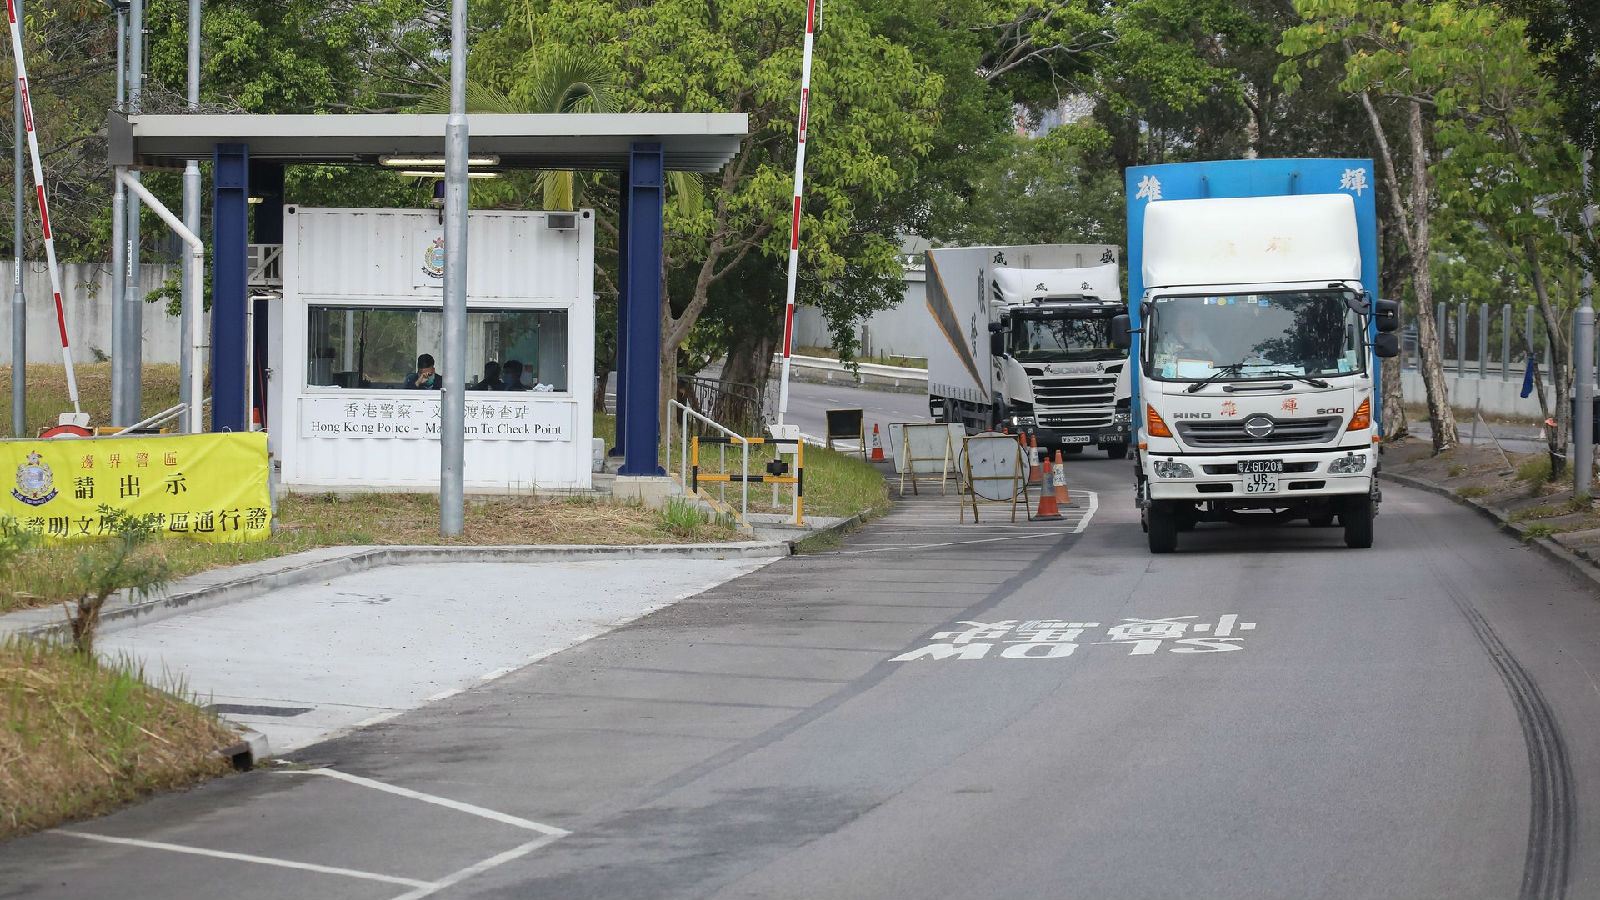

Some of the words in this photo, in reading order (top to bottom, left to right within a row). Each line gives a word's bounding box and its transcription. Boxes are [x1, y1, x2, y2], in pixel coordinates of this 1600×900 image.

[1135, 175, 1163, 202] 雄
[1338, 168, 1369, 197] 輝
[1316, 407, 1345, 415] 500
[312, 421, 340, 434] Hong
[344, 422, 374, 435] Kong
[377, 422, 410, 433] Police
[481, 423, 494, 434] To
[497, 423, 530, 434] Check
[534, 424, 562, 435] Point
[73, 472, 187, 499] 請出示
[1253, 473, 1268, 483] UR
[888, 638, 1245, 662] SLOW
